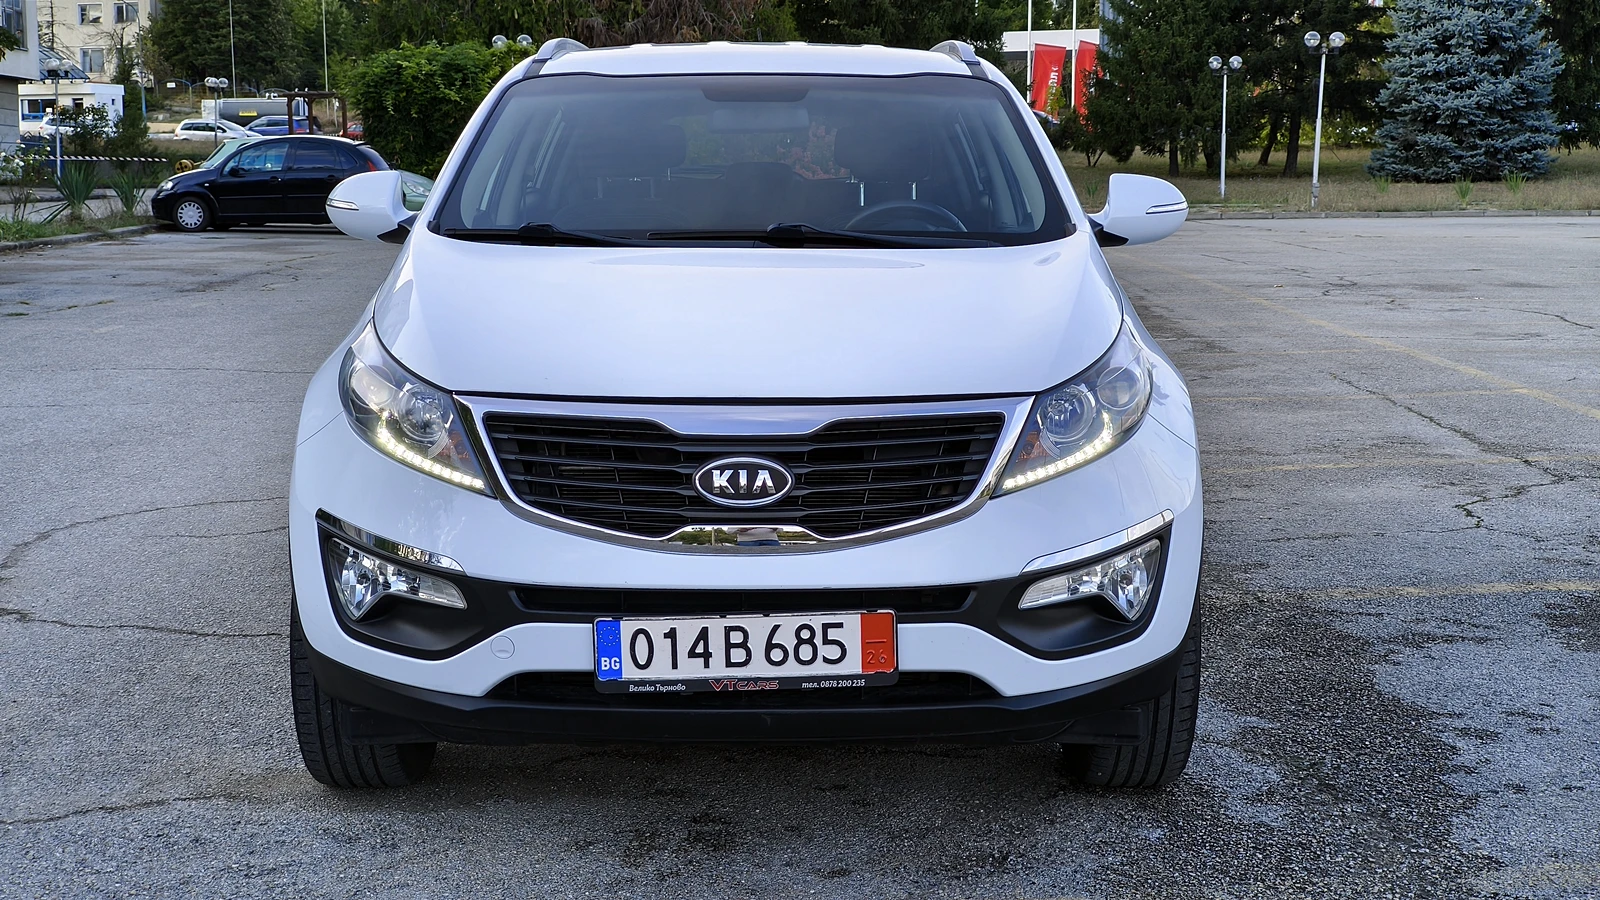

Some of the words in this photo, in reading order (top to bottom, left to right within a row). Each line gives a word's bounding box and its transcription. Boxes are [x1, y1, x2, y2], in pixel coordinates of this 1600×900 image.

[711, 469, 777, 494] KIA
[866, 649, 888, 664] 26
[601, 657, 620, 671] BG
[629, 684, 655, 692] Велико
[820, 680, 838, 688] 0878
[852, 679, 865, 687] 235
